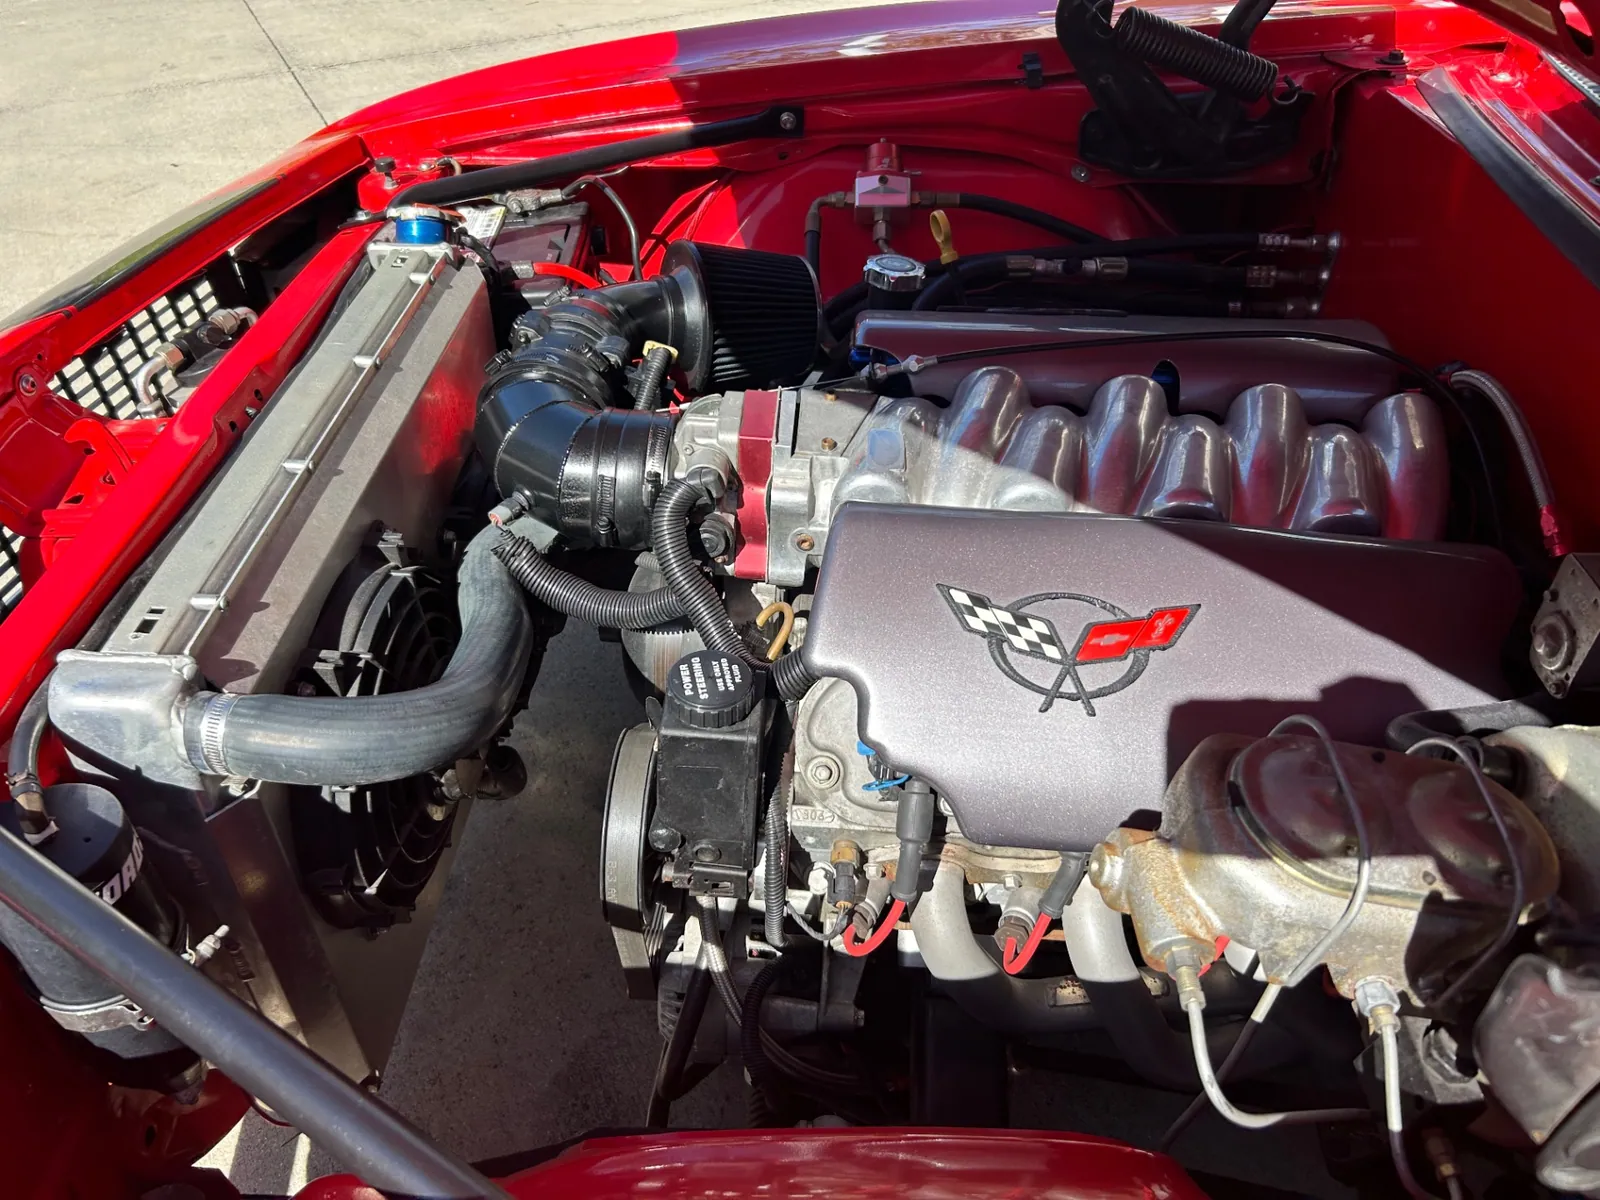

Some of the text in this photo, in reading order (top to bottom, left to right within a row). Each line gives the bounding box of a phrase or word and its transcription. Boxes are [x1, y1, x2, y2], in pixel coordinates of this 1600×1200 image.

[679, 663, 694, 696] POWER
[691, 657, 709, 700] STEERING
[711, 661, 725, 691] USE ONLY
[720, 658, 735, 691] APPROVED
[731, 664, 742, 683] FLUID
